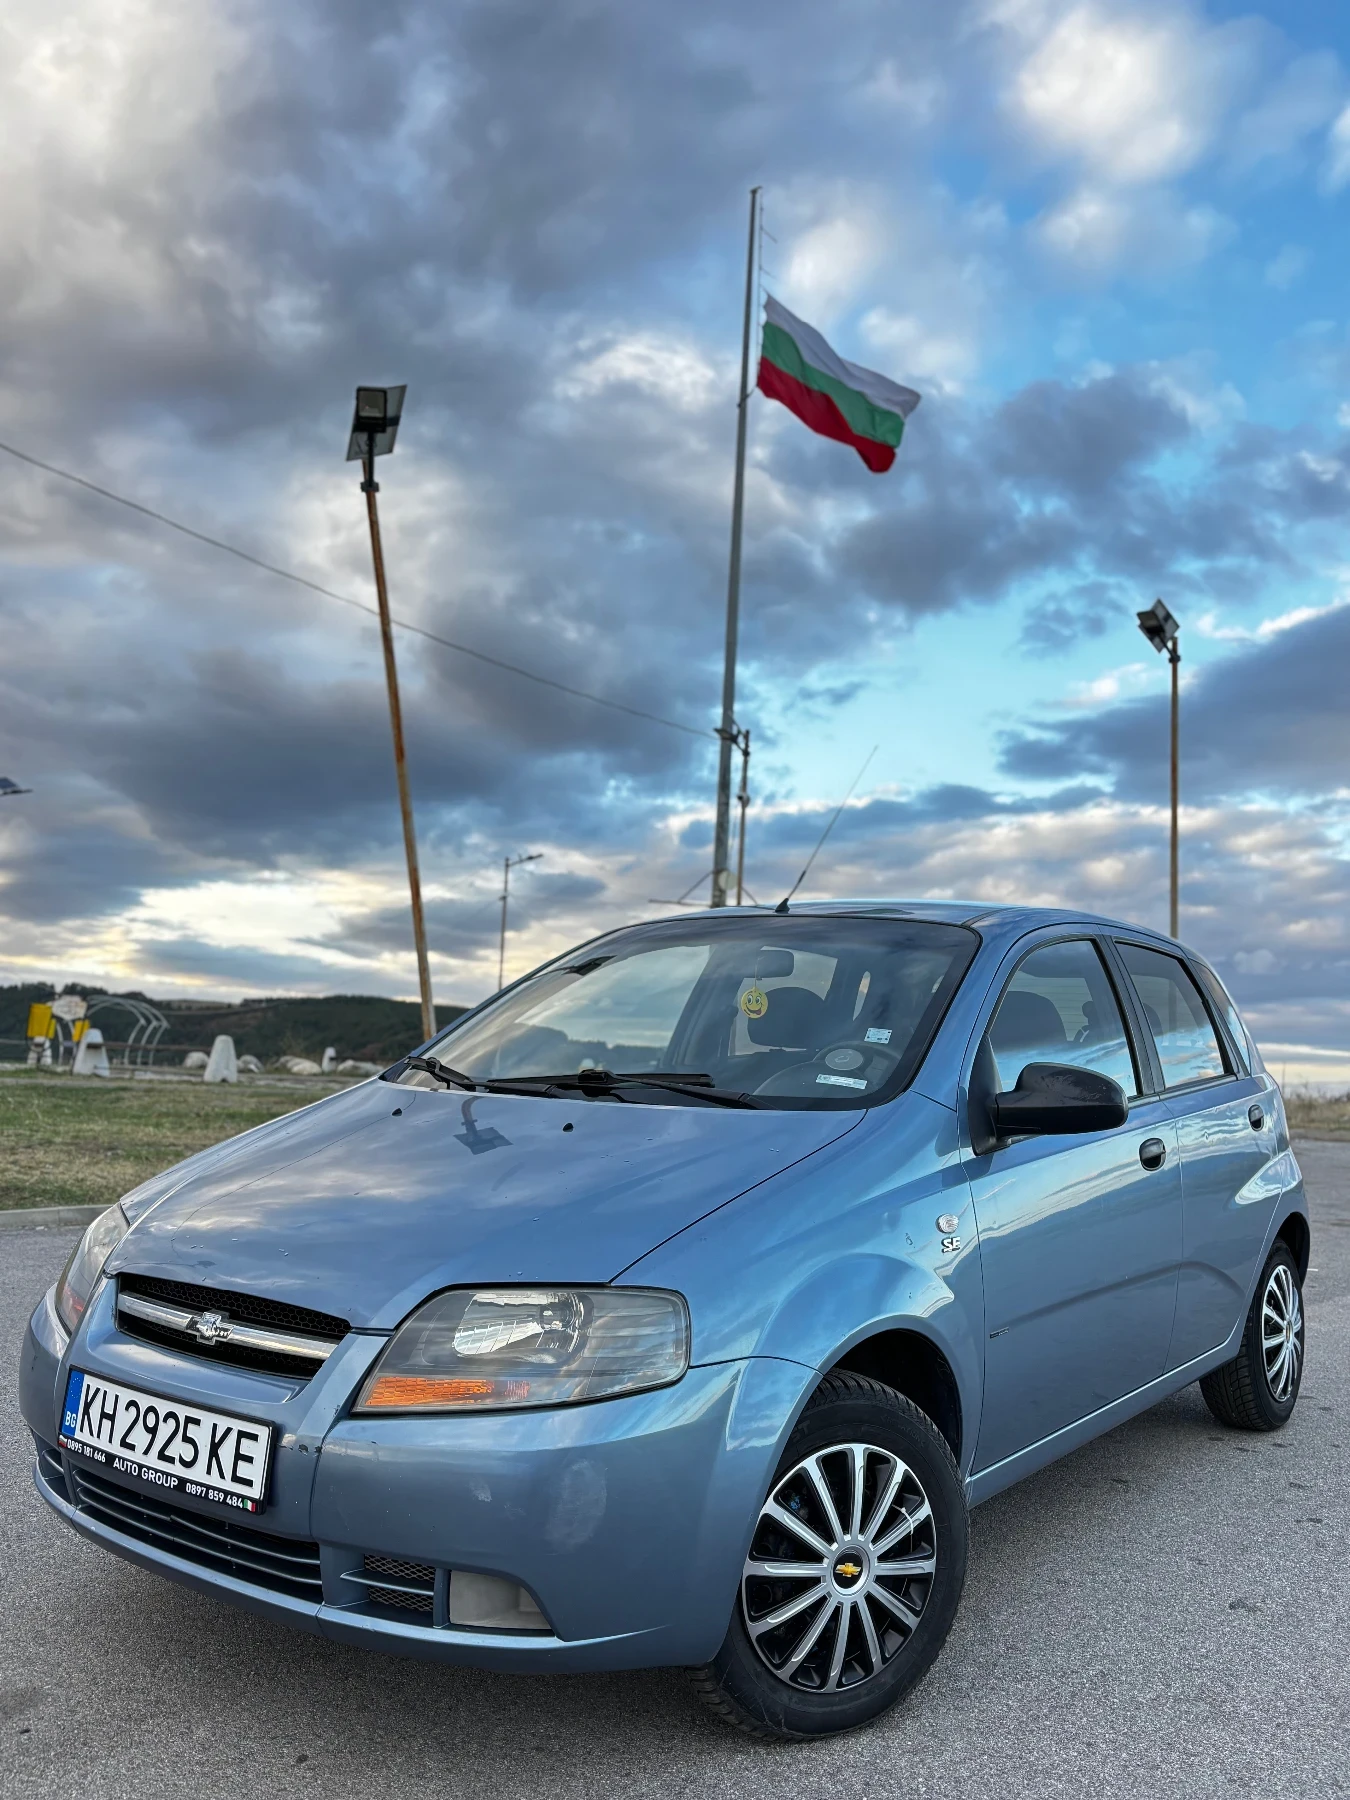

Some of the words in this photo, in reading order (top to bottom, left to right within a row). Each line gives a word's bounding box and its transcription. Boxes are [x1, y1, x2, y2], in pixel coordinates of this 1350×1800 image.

[941, 1236, 961, 1253] SE
[64, 1411, 77, 1428] BG
[67, 1439, 83, 1454] 0895
[83, 1445, 93, 1458] 181
[93, 1449, 106, 1463] 666
[113, 1457, 139, 1476] AUTO
[141, 1467, 179, 1489] GROUP
[185, 1482, 207, 1497] 0897
[208, 1489, 225, 1502] 859
[226, 1494, 243, 1509] 484
